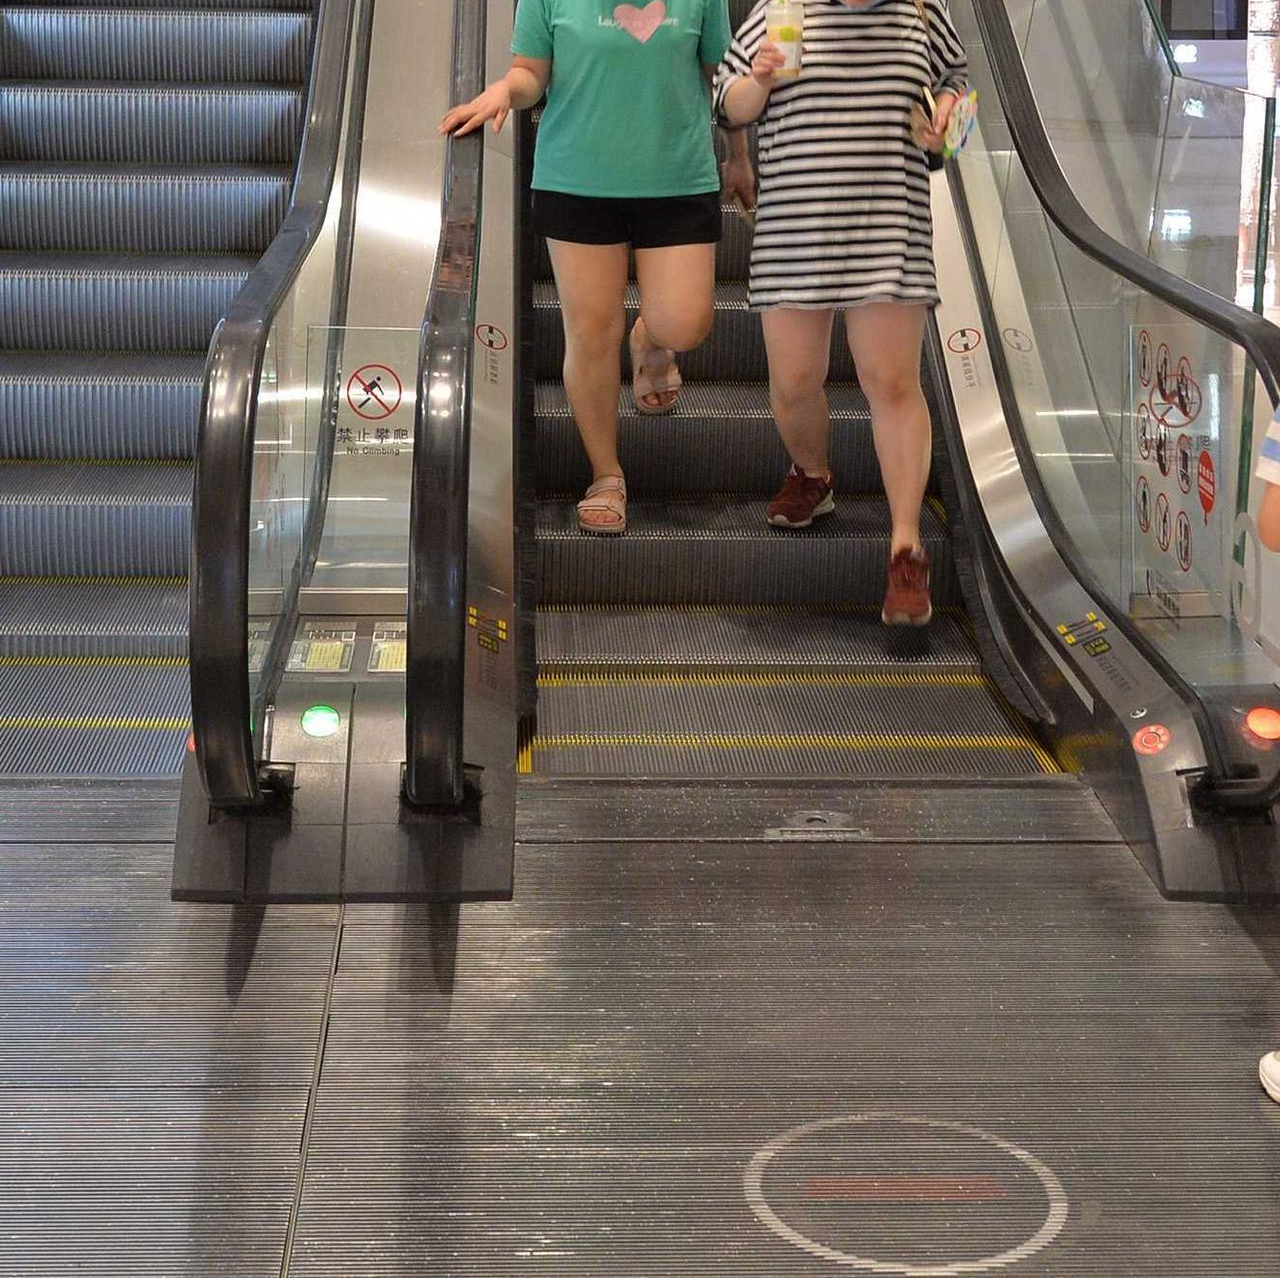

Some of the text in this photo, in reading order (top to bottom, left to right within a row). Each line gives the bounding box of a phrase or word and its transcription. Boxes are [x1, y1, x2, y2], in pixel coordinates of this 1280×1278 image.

[337, 426, 410, 445] 禁止攀爬
[347, 446, 401, 457] No Climbing
